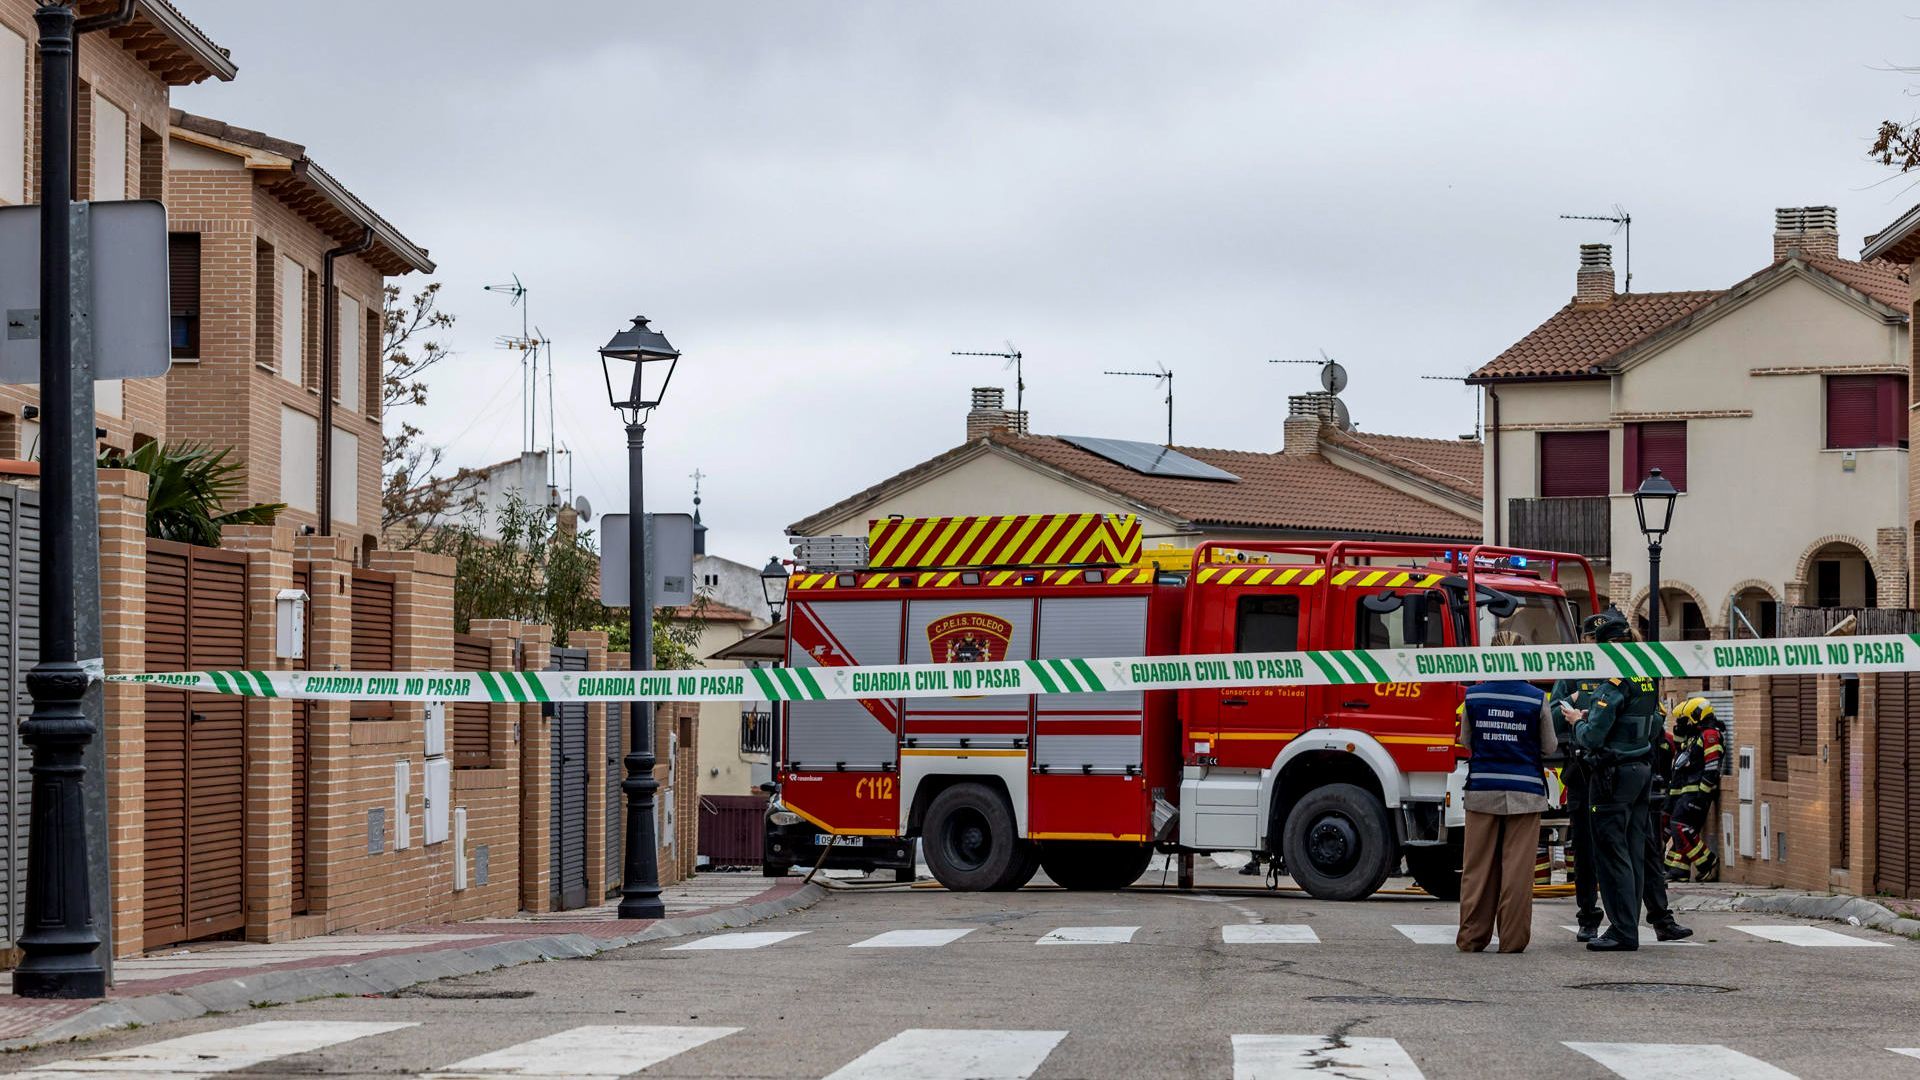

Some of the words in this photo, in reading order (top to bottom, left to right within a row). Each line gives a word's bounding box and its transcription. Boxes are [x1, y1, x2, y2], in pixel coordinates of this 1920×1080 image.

[971, 617, 1004, 632] TOLEDO
[1415, 653, 1480, 675] GUARDIA
[1481, 652, 1519, 674] CIVIL
[1520, 650, 1545, 673] NO
[1546, 650, 1597, 673] PASAR
[1713, 644, 1781, 670] GUARDIA
[1784, 643, 1824, 668] CIVIL
[1826, 640, 1851, 666] NO
[1853, 639, 1905, 665] PASAR
[851, 670, 912, 693] GUARDIA
[914, 670, 948, 690] CIVIL
[953, 669, 973, 690] NO
[976, 667, 1022, 689] PASAR
[1130, 660, 1193, 685] GUARDIA
[1195, 659, 1232, 682] CIVIL
[1233, 659, 1255, 681] NO
[1257, 658, 1305, 680] PASAR
[303, 676, 364, 694] GUARDIA
[366, 676, 400, 696] CIVIL
[404, 677, 425, 696] NO
[427, 677, 472, 697] PASAR
[576, 676, 637, 697] GUARDIA
[639, 676, 674, 696] CIVIL
[676, 676, 697, 696] NO
[699, 675, 745, 696] PASAR
[1278, 688, 1305, 697] Toledo
[1374, 682, 1422, 698] CPEIS
[1487, 708, 1515, 718] LETRADO
[1482, 732, 1491, 741] DE
[1491, 733, 1519, 742] JUSTICIA
[868, 777, 893, 800] 112
